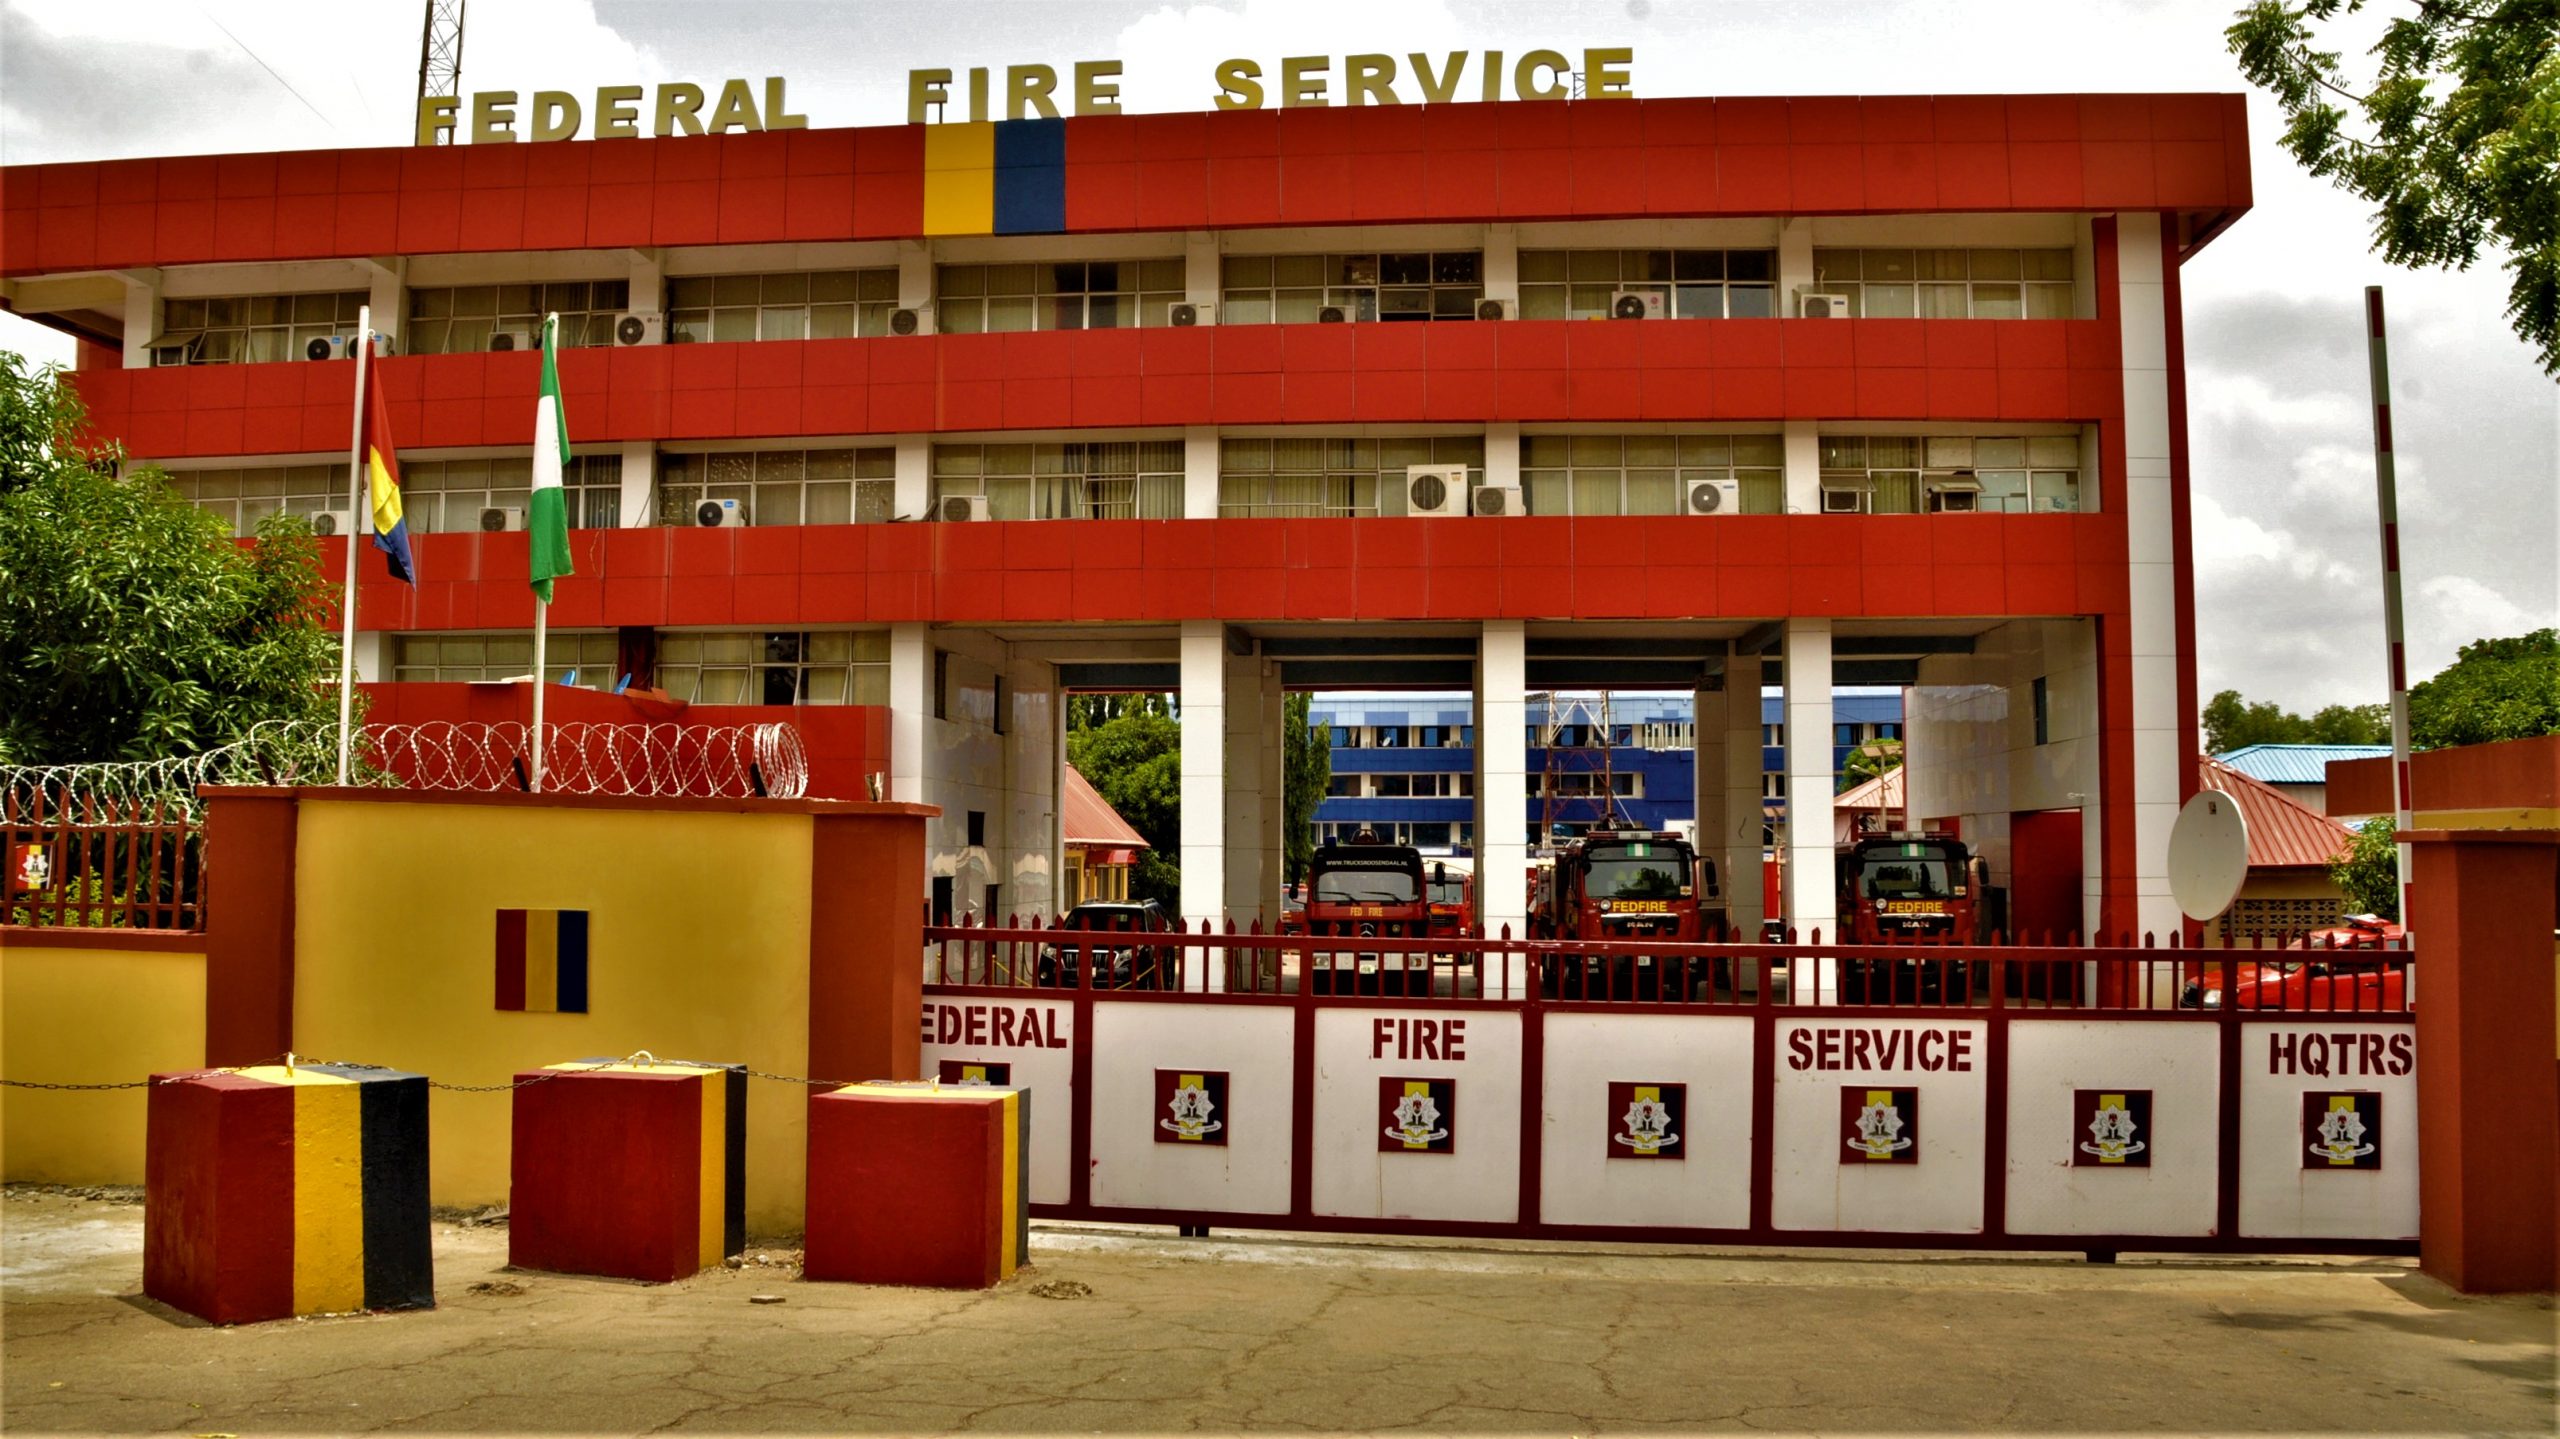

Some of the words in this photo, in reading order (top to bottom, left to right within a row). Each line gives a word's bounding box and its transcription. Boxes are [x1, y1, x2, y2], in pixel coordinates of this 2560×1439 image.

[419, 76, 808, 145] FEDERAL
[908, 60, 1123, 124] FIRE
[1213, 47, 1634, 110] SERVICE
[1350, 906, 1363, 917] FED
[1368, 906, 1383, 917] FIRE
[1612, 901, 1668, 912] FEDFIRE
[1888, 902, 1943, 913] FEDFIRE
[1373, 1018, 1466, 1060] FIRE
[1788, 1028, 1973, 1072] SERVICE
[2270, 1032, 2413, 1078] HQTRS
